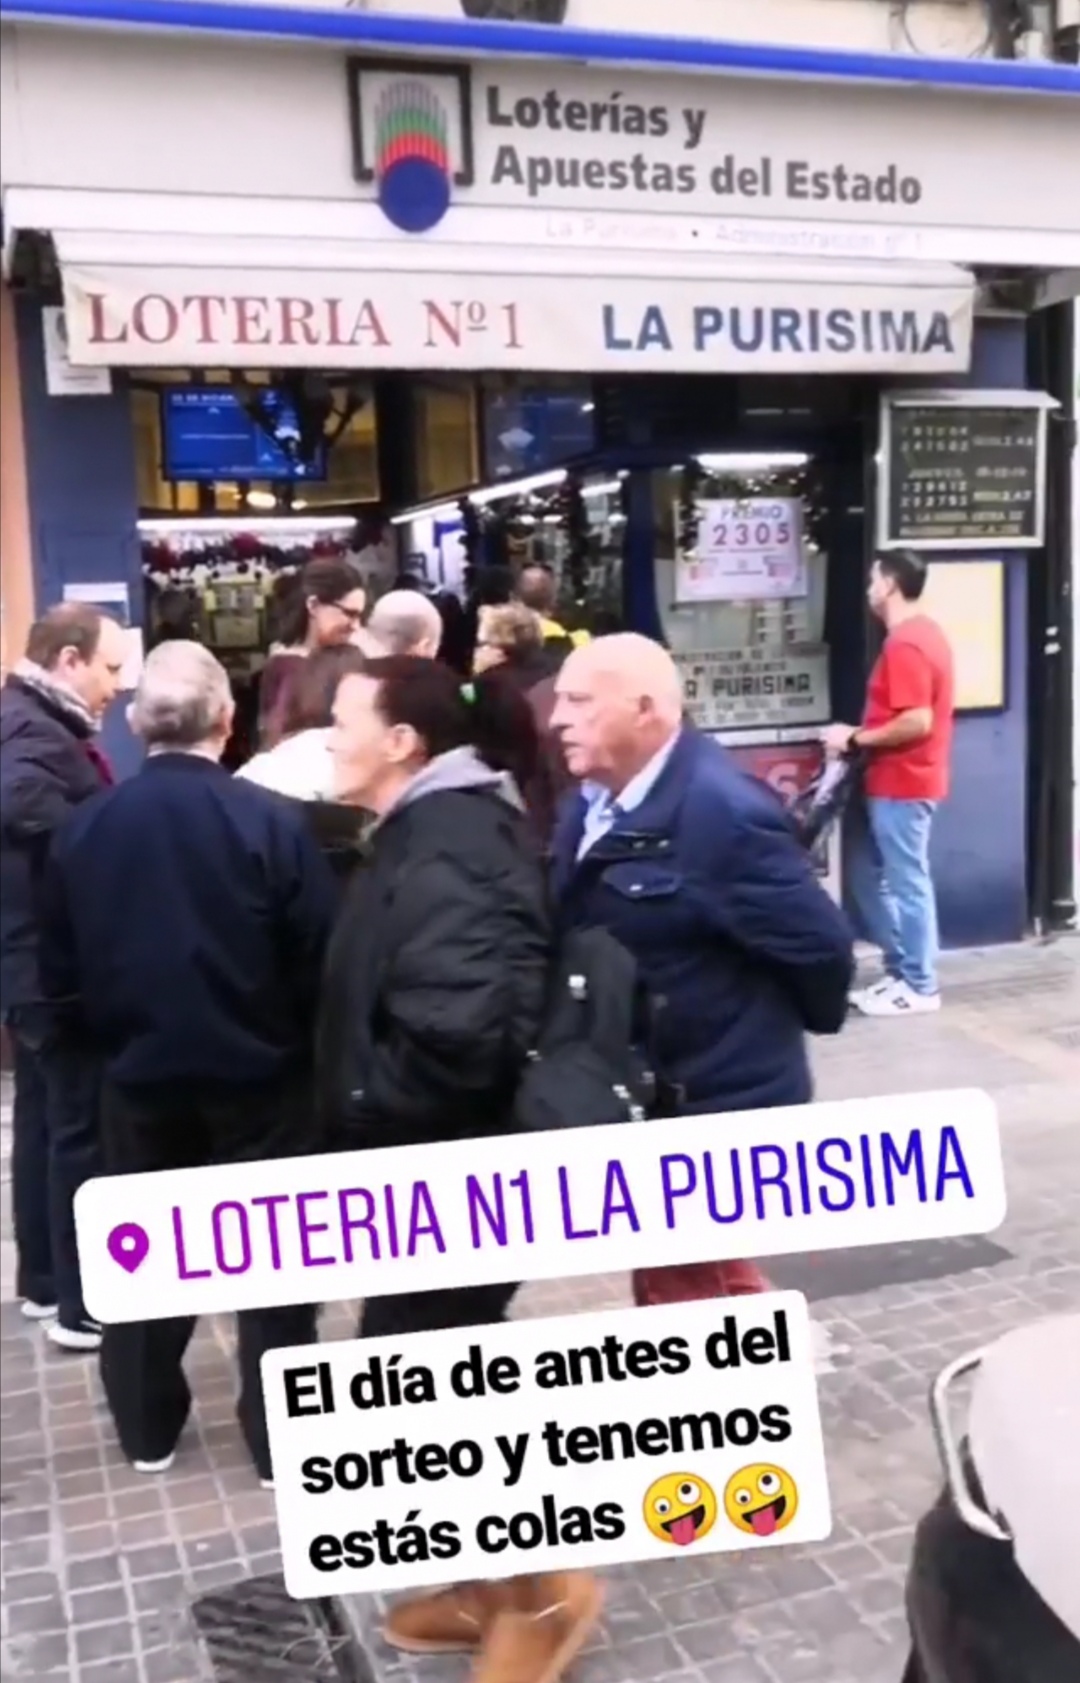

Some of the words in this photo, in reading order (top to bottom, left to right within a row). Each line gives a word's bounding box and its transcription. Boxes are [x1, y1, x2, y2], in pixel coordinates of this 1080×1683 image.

[486, 86, 669, 136] Loterías
[681, 107, 708, 150] y
[492, 145, 696, 196] Apuestas
[711, 155, 770, 196] del
[786, 161, 922, 204] Estado
[85, 292, 390, 346] LOTERIA
[503, 303, 524, 348] 1
[602, 305, 672, 350] LA
[693, 307, 954, 354] PURISIMA
[712, 522, 791, 546] 2305
[720, 504, 783, 519] PREMIO
[712, 673, 811, 697] PURISIMA
